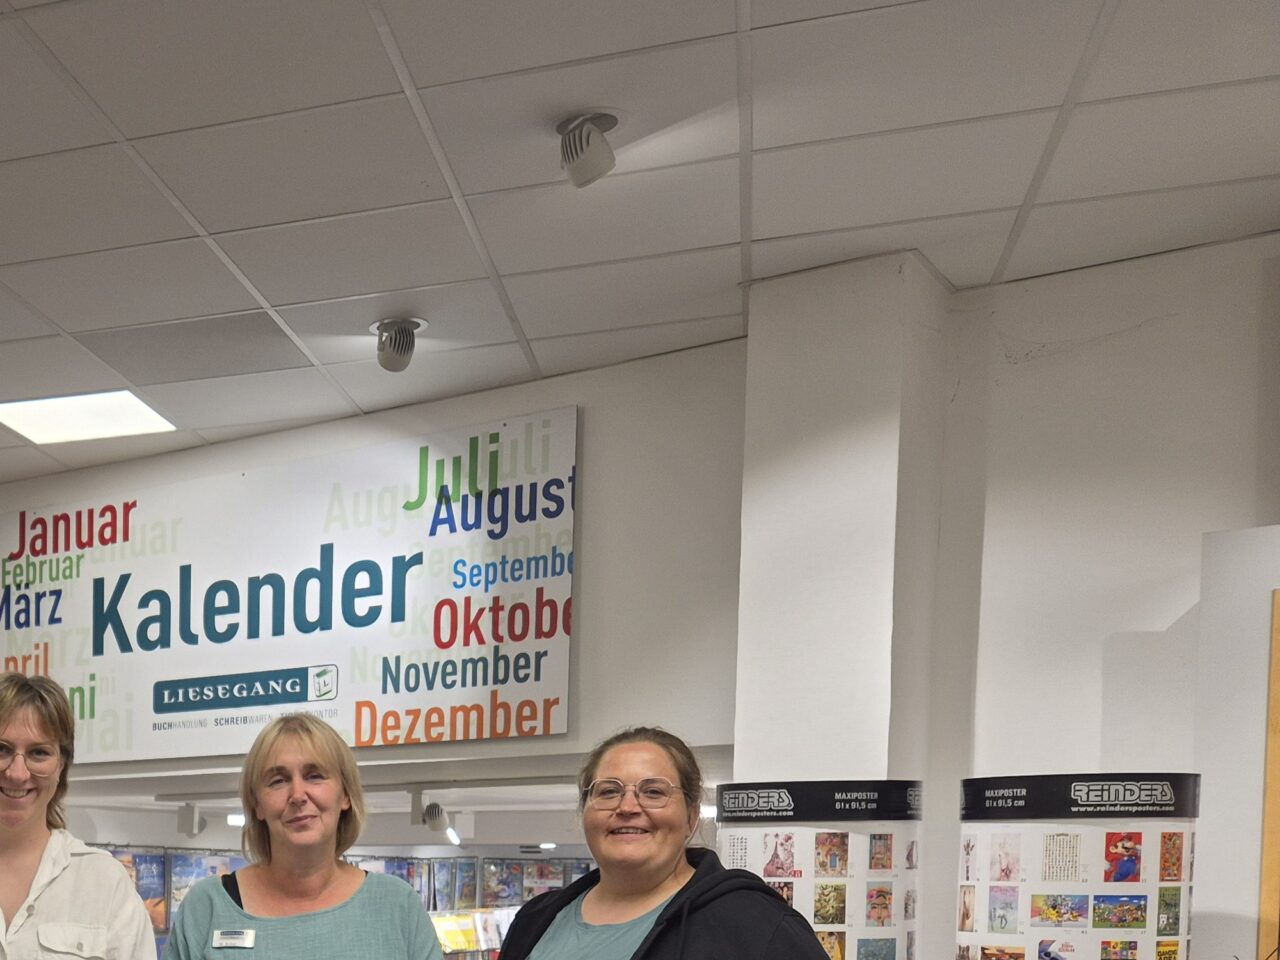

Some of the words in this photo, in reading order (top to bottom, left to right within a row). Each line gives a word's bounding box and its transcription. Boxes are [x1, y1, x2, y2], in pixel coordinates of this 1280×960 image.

[402, 431, 500, 511] Juli
[429, 465, 576, 540] August
[8, 500, 137, 561] Januar
[1, 552, 85, 590] Februar
[92, 542, 424, 657] Kalender
[162, 678, 302, 704] LIESEGANG
[381, 645, 548, 695] November
[354, 689, 560, 747] Dezember
[835, 791, 879, 801] MAXIPOSTER
[985, 788, 1027, 798] MAXIPOSTER
